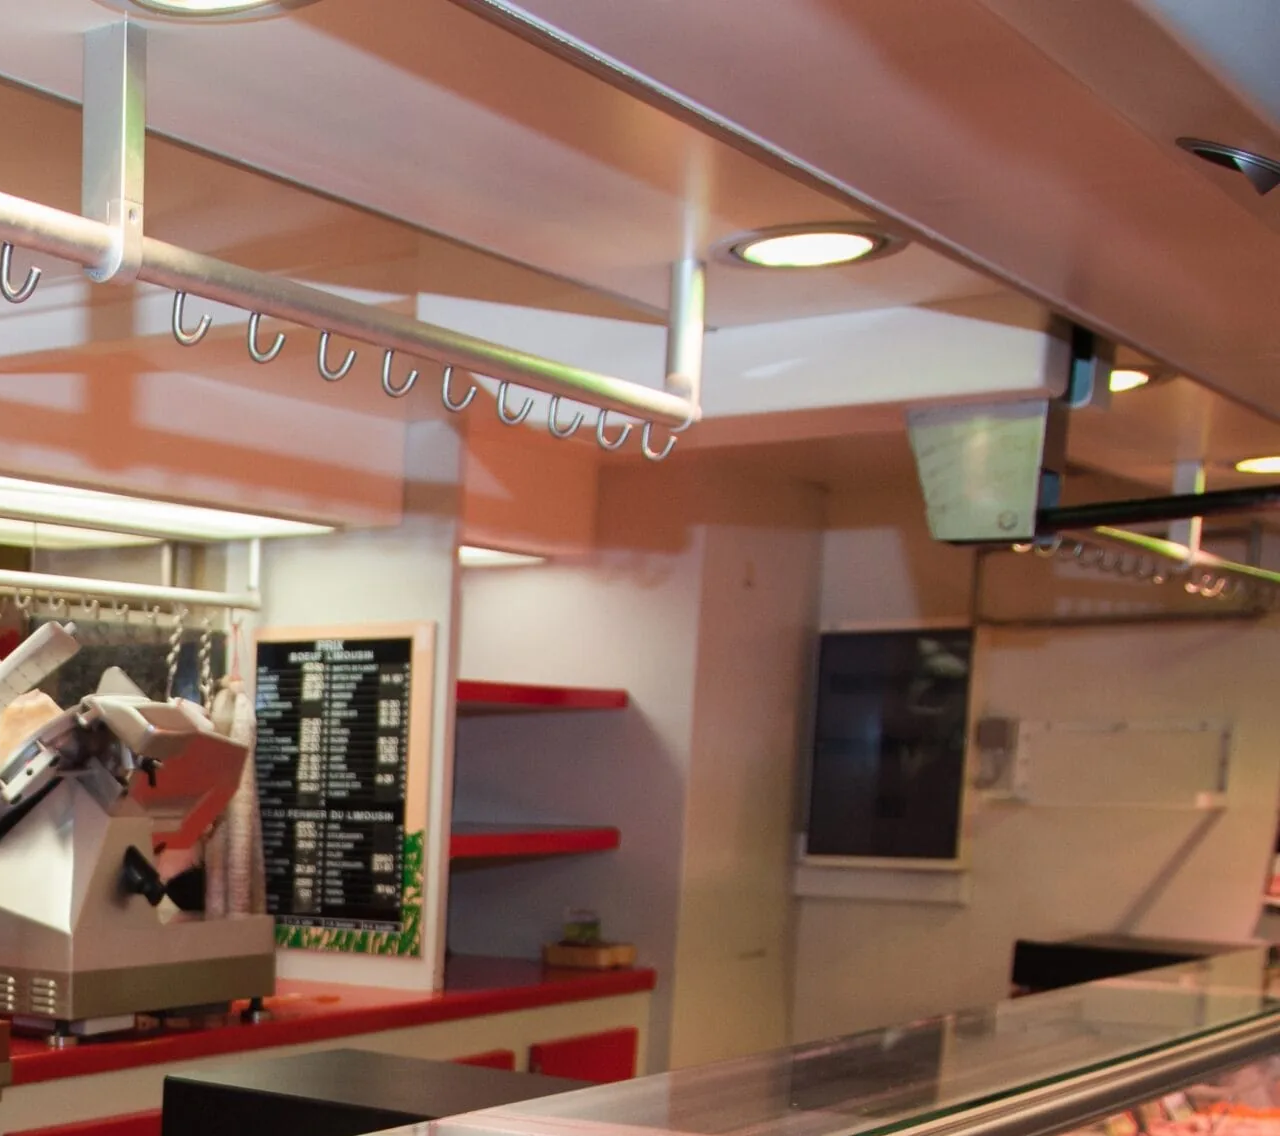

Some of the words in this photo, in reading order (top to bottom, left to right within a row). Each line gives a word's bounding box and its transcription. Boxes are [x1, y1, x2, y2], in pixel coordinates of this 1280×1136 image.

[327, 650, 374, 661] LIMOUSIN
[331, 811, 344, 819] DU
[348, 811, 394, 821] LIMOUSIN
